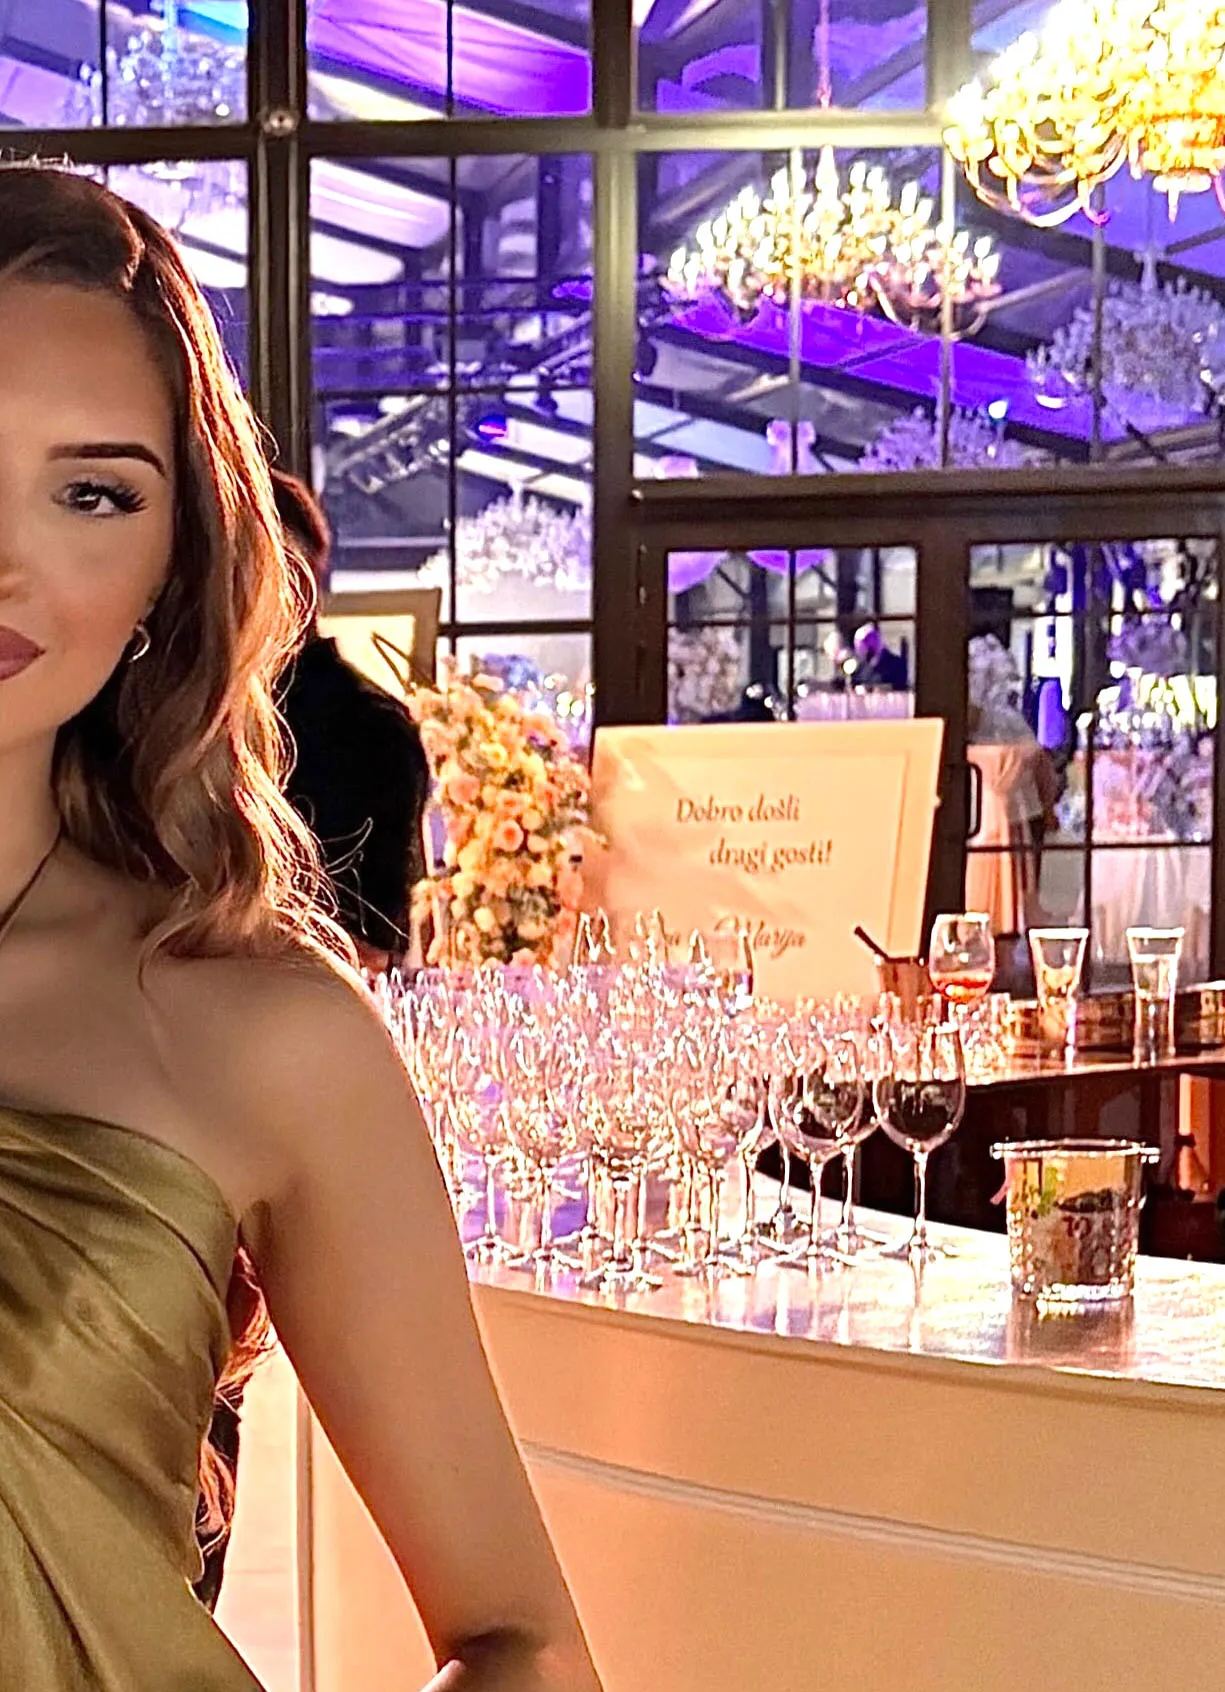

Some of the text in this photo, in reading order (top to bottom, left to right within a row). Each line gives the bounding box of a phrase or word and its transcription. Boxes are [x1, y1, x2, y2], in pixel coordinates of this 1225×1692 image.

[676, 792, 800, 823] Dobro došli
[709, 837, 833, 874] dragi gosti!
